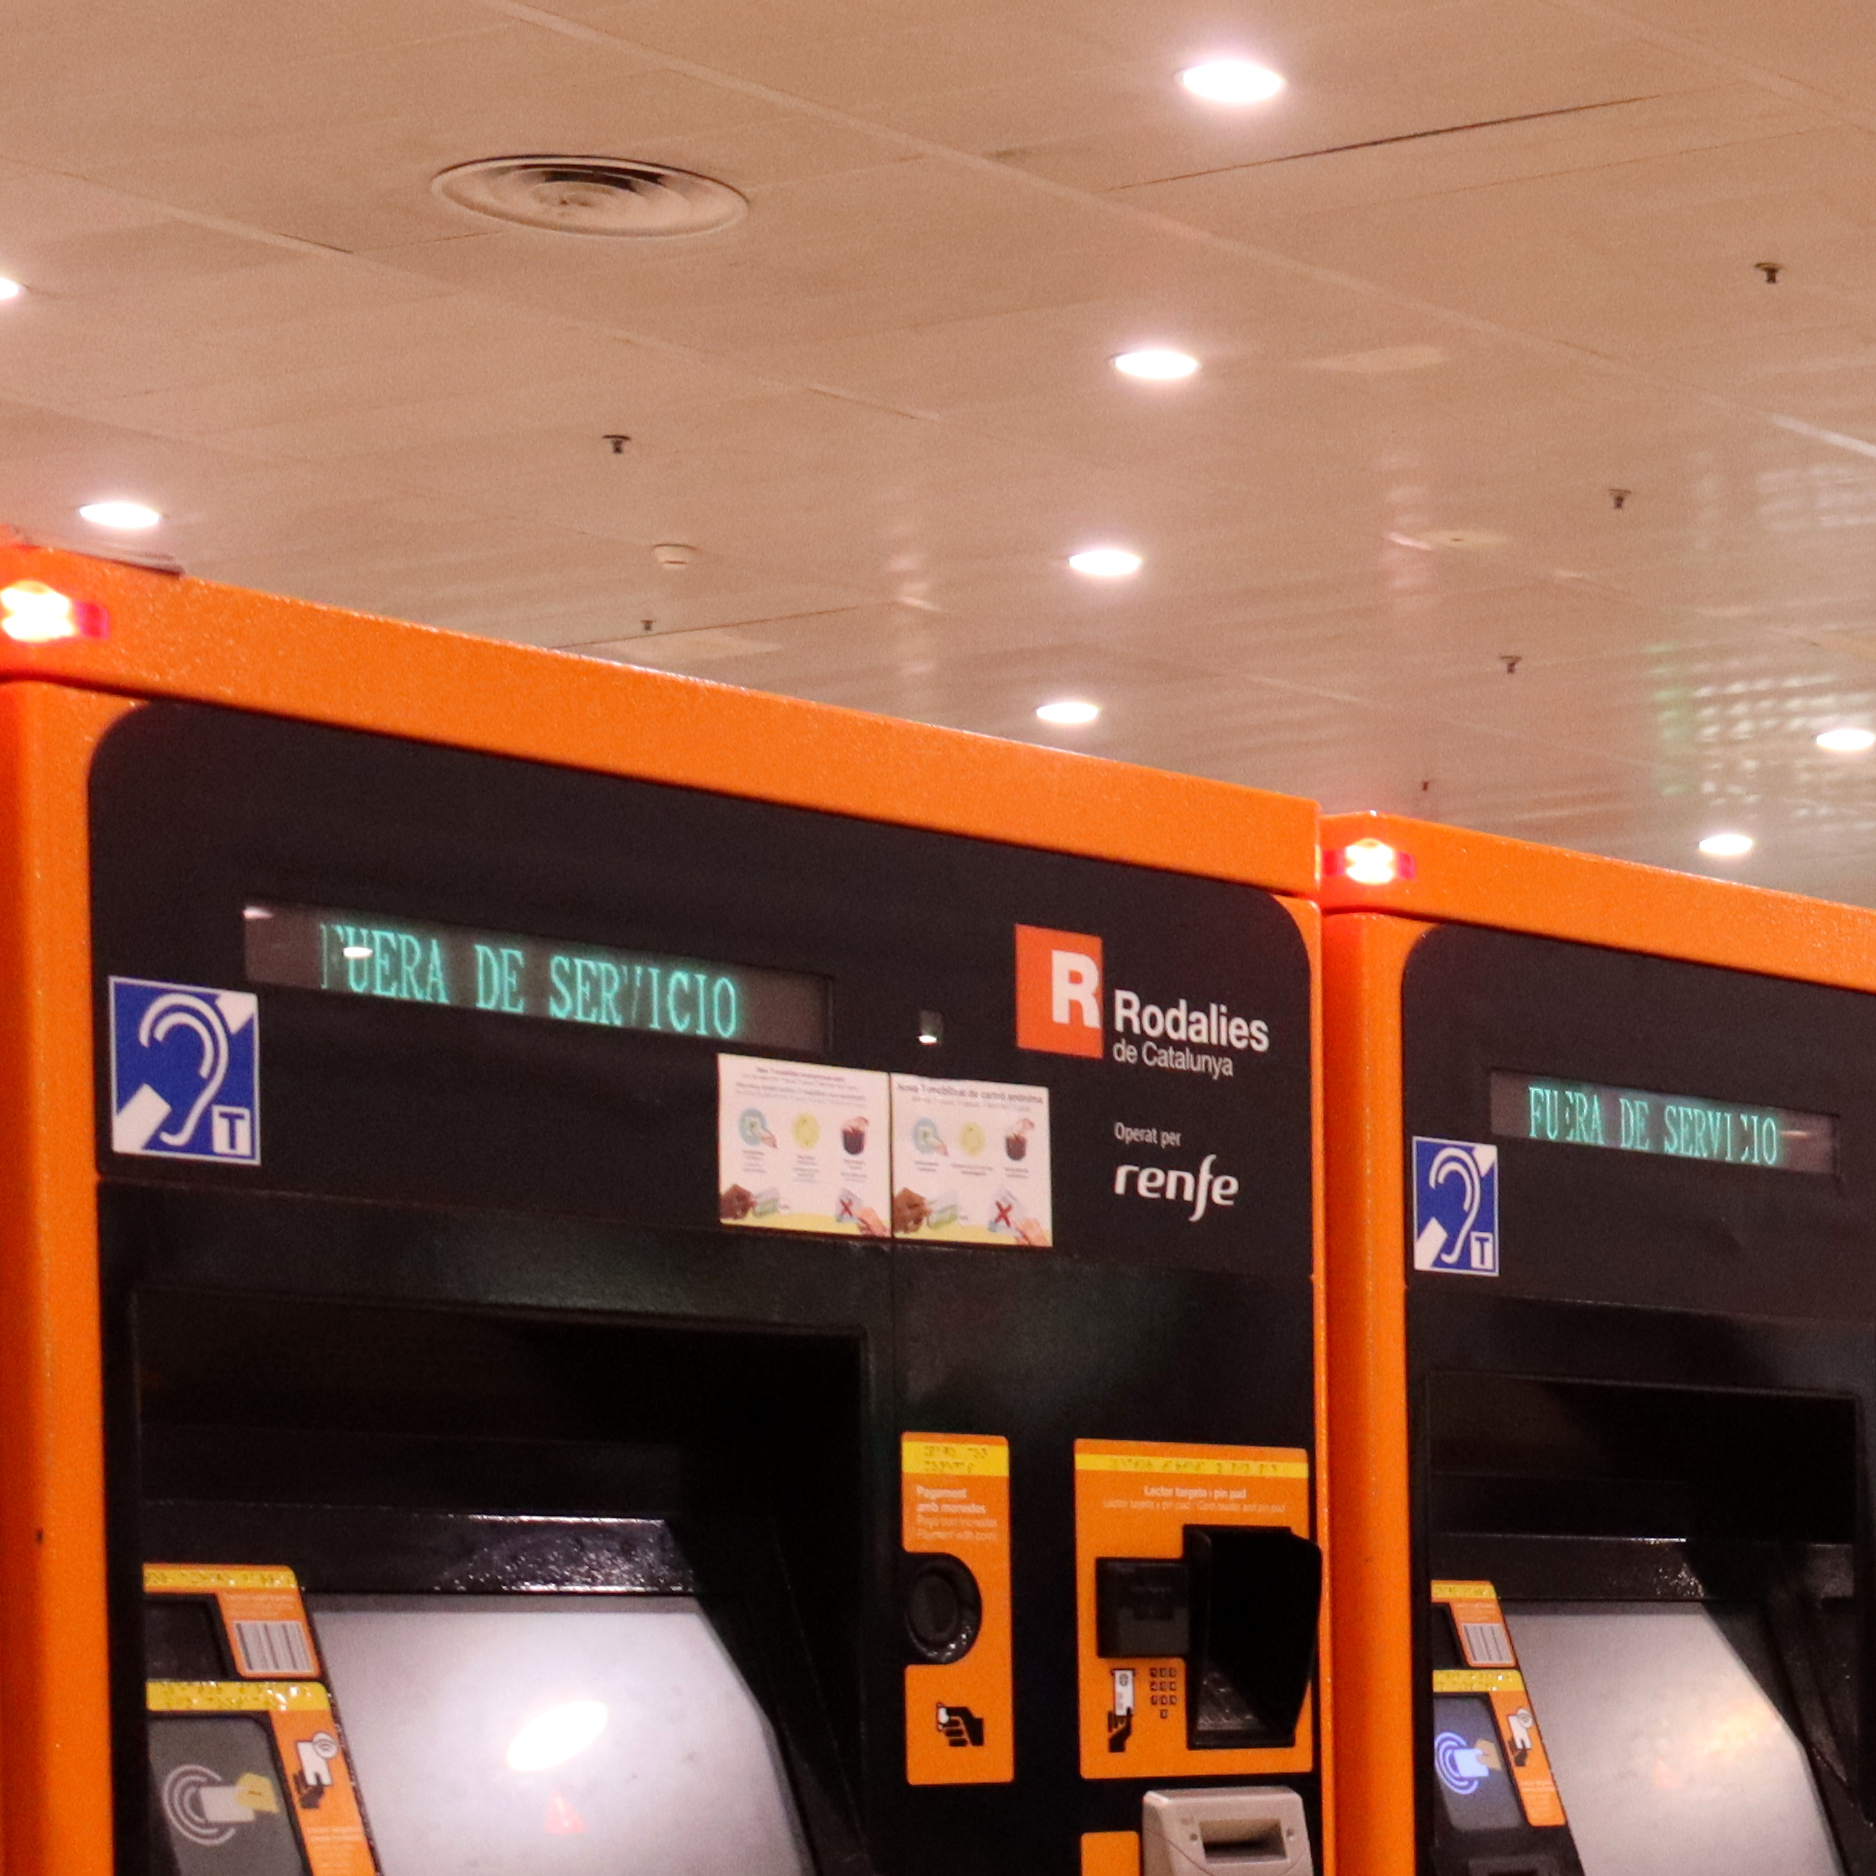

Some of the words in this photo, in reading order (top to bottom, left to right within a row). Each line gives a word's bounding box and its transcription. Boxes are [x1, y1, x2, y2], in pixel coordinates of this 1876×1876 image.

[475, 944, 526, 1014] DE
[1052, 949, 1101, 1029] R
[1114, 989, 1270, 1053] Rodalies
[1113, 1039, 1138, 1064] de
[1142, 1041, 1234, 1080] Catalunya
[1114, 1121, 1158, 1145] Operat
[1161, 1129, 1182, 1150] per
[1619, 1098, 1649, 1149] DE
[1114, 1153, 1240, 1223] renfe
